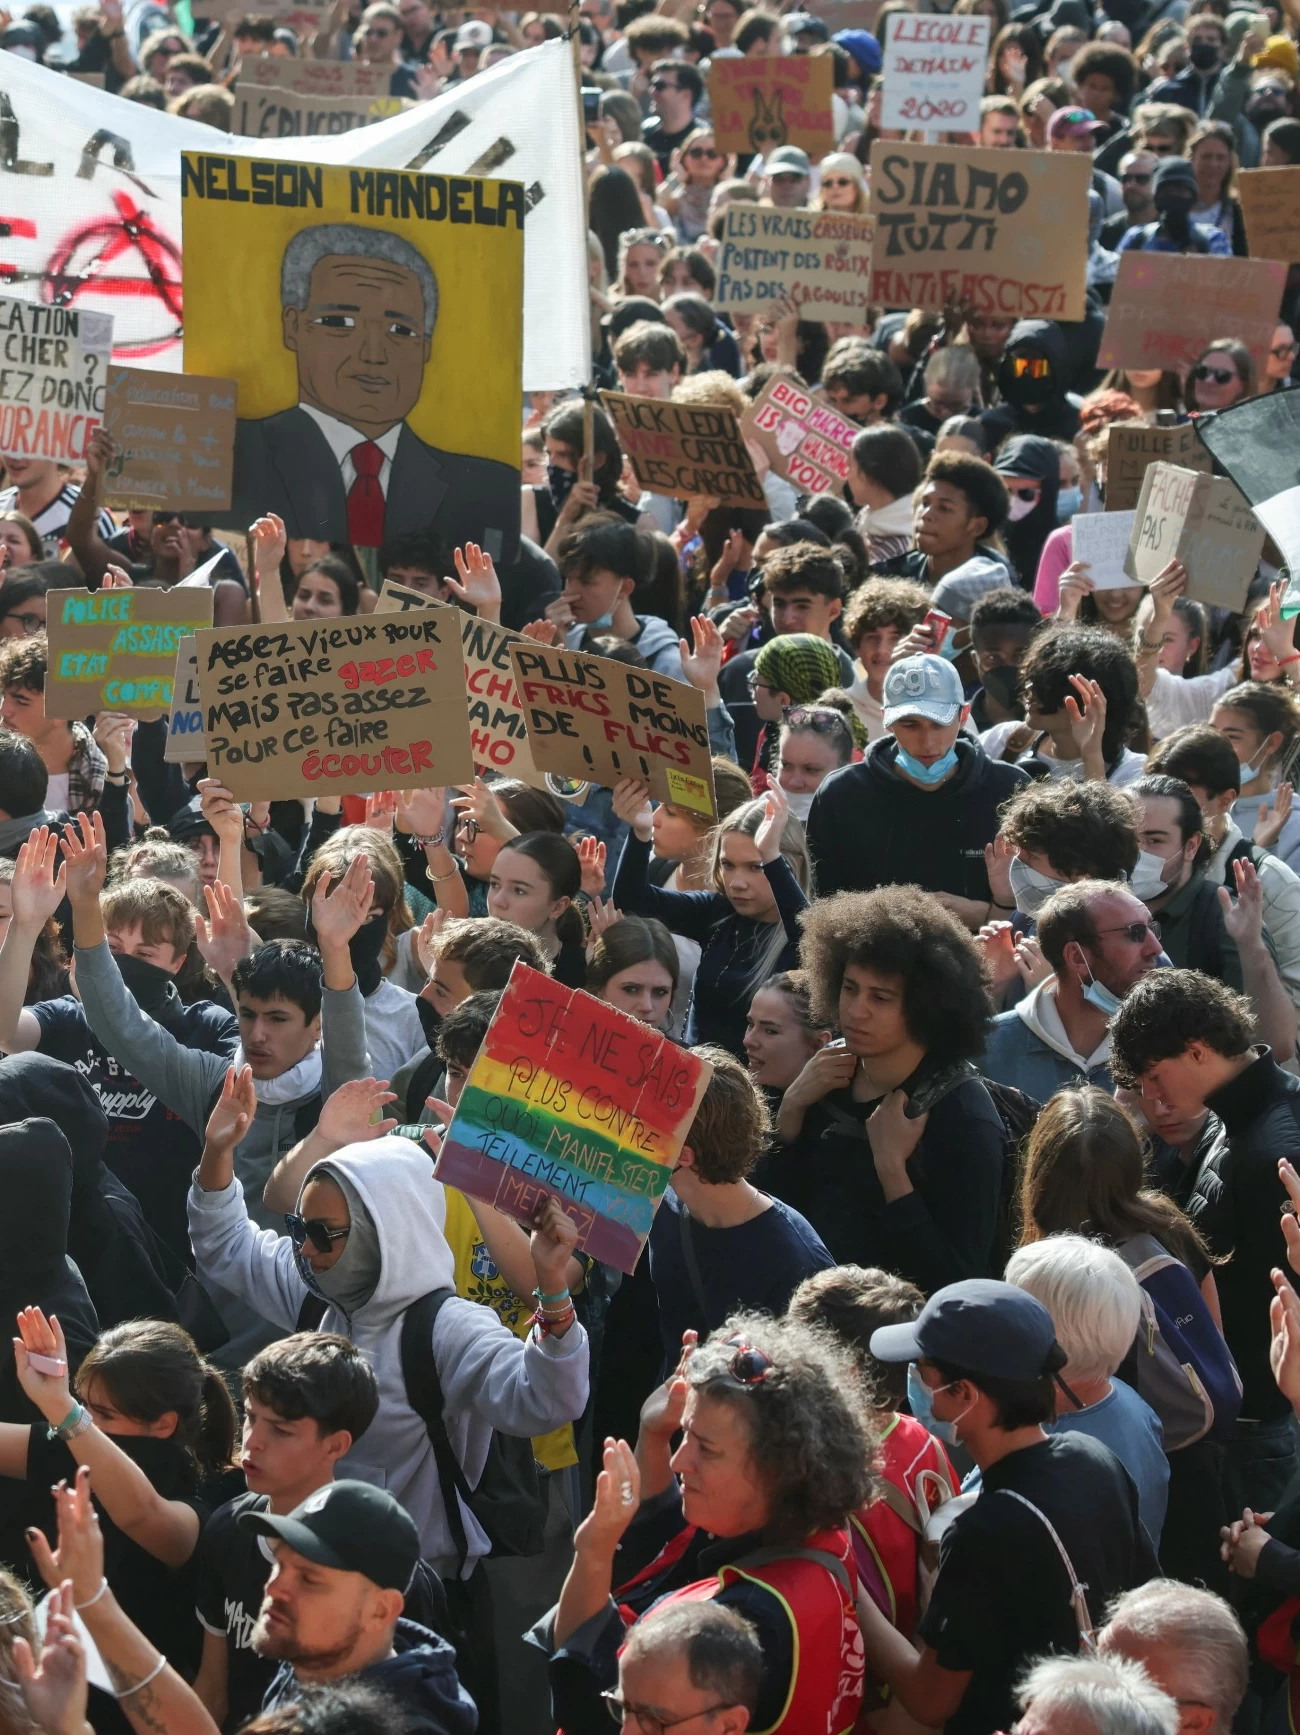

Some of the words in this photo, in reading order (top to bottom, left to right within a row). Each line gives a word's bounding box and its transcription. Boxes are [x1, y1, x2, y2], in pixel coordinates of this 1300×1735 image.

[181, 156, 324, 208] NELSON
[350, 168, 526, 230] MANDELA
[728, 212, 756, 237] LES
[762, 215, 812, 239] VRAIS
[722, 242, 790, 271] PORTENT
[794, 253, 821, 269] DES
[718, 274, 753, 303] PAS
[756, 281, 788, 299] DES
[791, 281, 868, 308] CAGOULES
[4, 333, 69, 368] CHER
[83, 353, 99, 385] ?
[41, 375, 106, 412] DONC
[772, 383, 810, 416] BIG
[607, 399, 673, 432] FUCK
[756, 405, 781, 431] IS
[617, 428, 681, 458] VIVE
[1117, 433, 1173, 454] NULLE
[631, 456, 677, 489] LES
[788, 455, 832, 493] YOU
[1142, 514, 1168, 551] PAS
[61, 594, 134, 625] POLICE
[59, 652, 109, 677] ETAT
[514, 650, 606, 690] PLUS
[625, 673, 676, 711] DE
[888, 663, 940, 697] cgt
[217, 673, 249, 695] se
[530, 708, 580, 738] DE
[518, 998, 573, 1054] JE
[579, 1022, 628, 1074] NE
[626, 1043, 690, 1108] SAIS
[91, 1083, 158, 1119] Supply
[508, 1055, 573, 1113] PLUS
[577, 1085, 662, 1153] CONTRE
[476, 1132, 595, 1203] TELLEMENT
